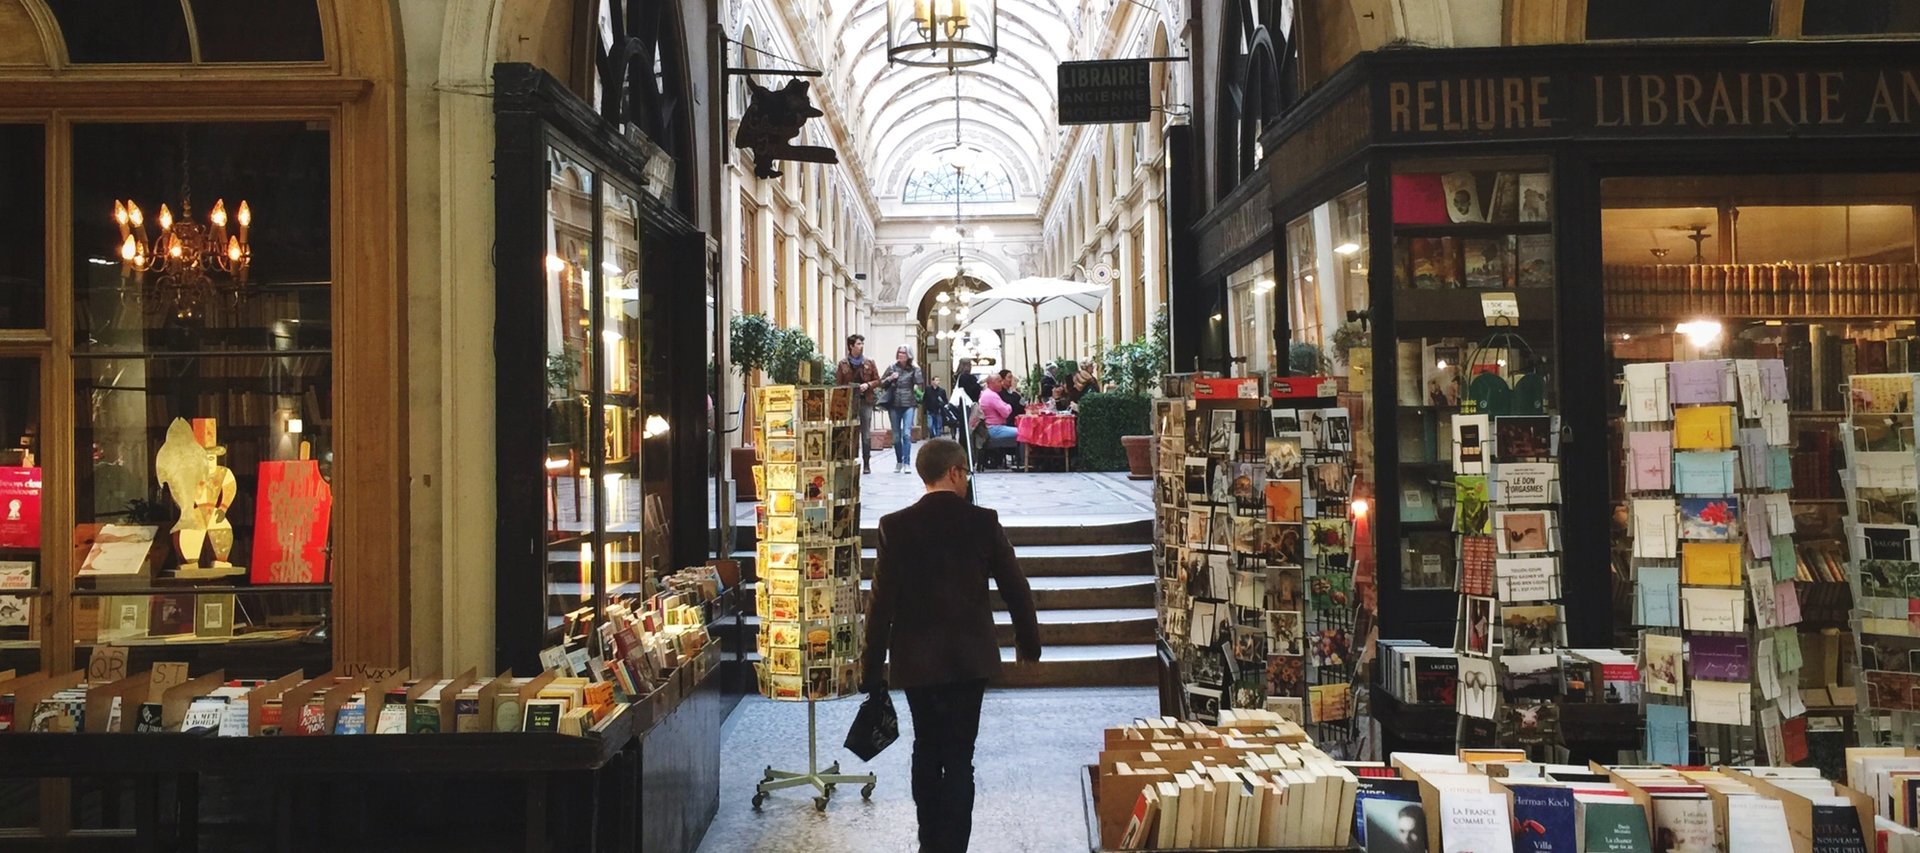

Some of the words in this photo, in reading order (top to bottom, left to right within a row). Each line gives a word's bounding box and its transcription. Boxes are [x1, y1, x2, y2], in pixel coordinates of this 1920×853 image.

[1061, 64, 1146, 88] LIBRAIRIE
[1062, 89, 1146, 103] ANCIENNE
[1593, 71, 1846, 127] LIBRAIRIE
[1389, 76, 1551, 132] RELIURE
[1513, 477, 1521, 485] LE
[1522, 477, 1536, 485] DON
[270, 562, 312, 584] STARS
[1515, 796, 1547, 807] Herman
[1548, 797, 1570, 808] Koch
[1452, 807, 1463, 816] LA
[1465, 807, 1496, 816] FRANCE
[1453, 817, 1484, 825] COMME
[1533, 840, 1552, 850] Villa
